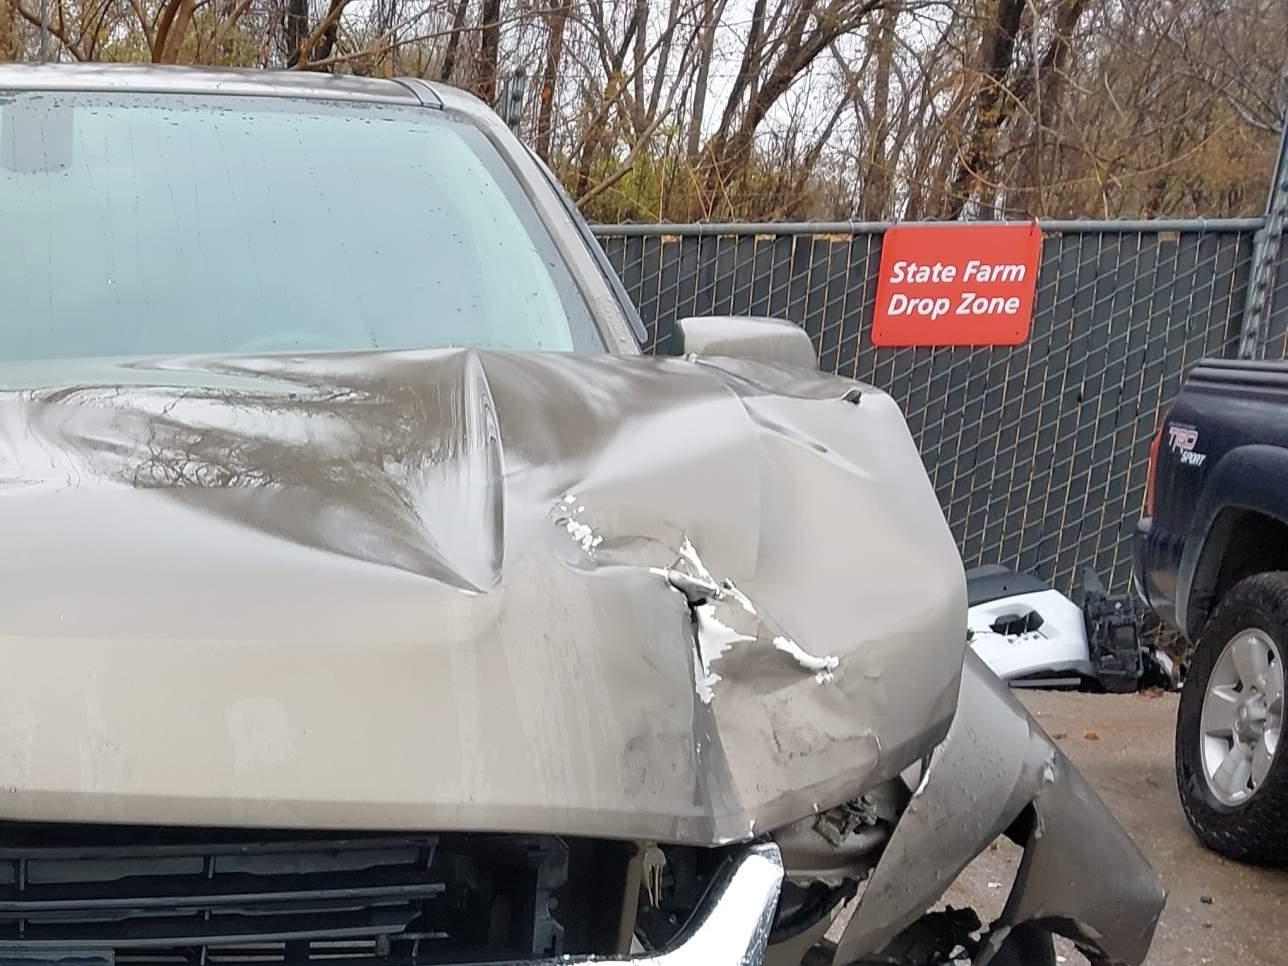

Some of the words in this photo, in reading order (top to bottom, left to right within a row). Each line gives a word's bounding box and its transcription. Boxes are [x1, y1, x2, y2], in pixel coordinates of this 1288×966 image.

[889, 260, 957, 284] State
[962, 259, 1026, 283] Farm
[887, 293, 951, 321] Drop
[955, 292, 1020, 315] Zone
[1168, 426, 1199, 454] TRD
[1180, 450, 1207, 467] SPORT
